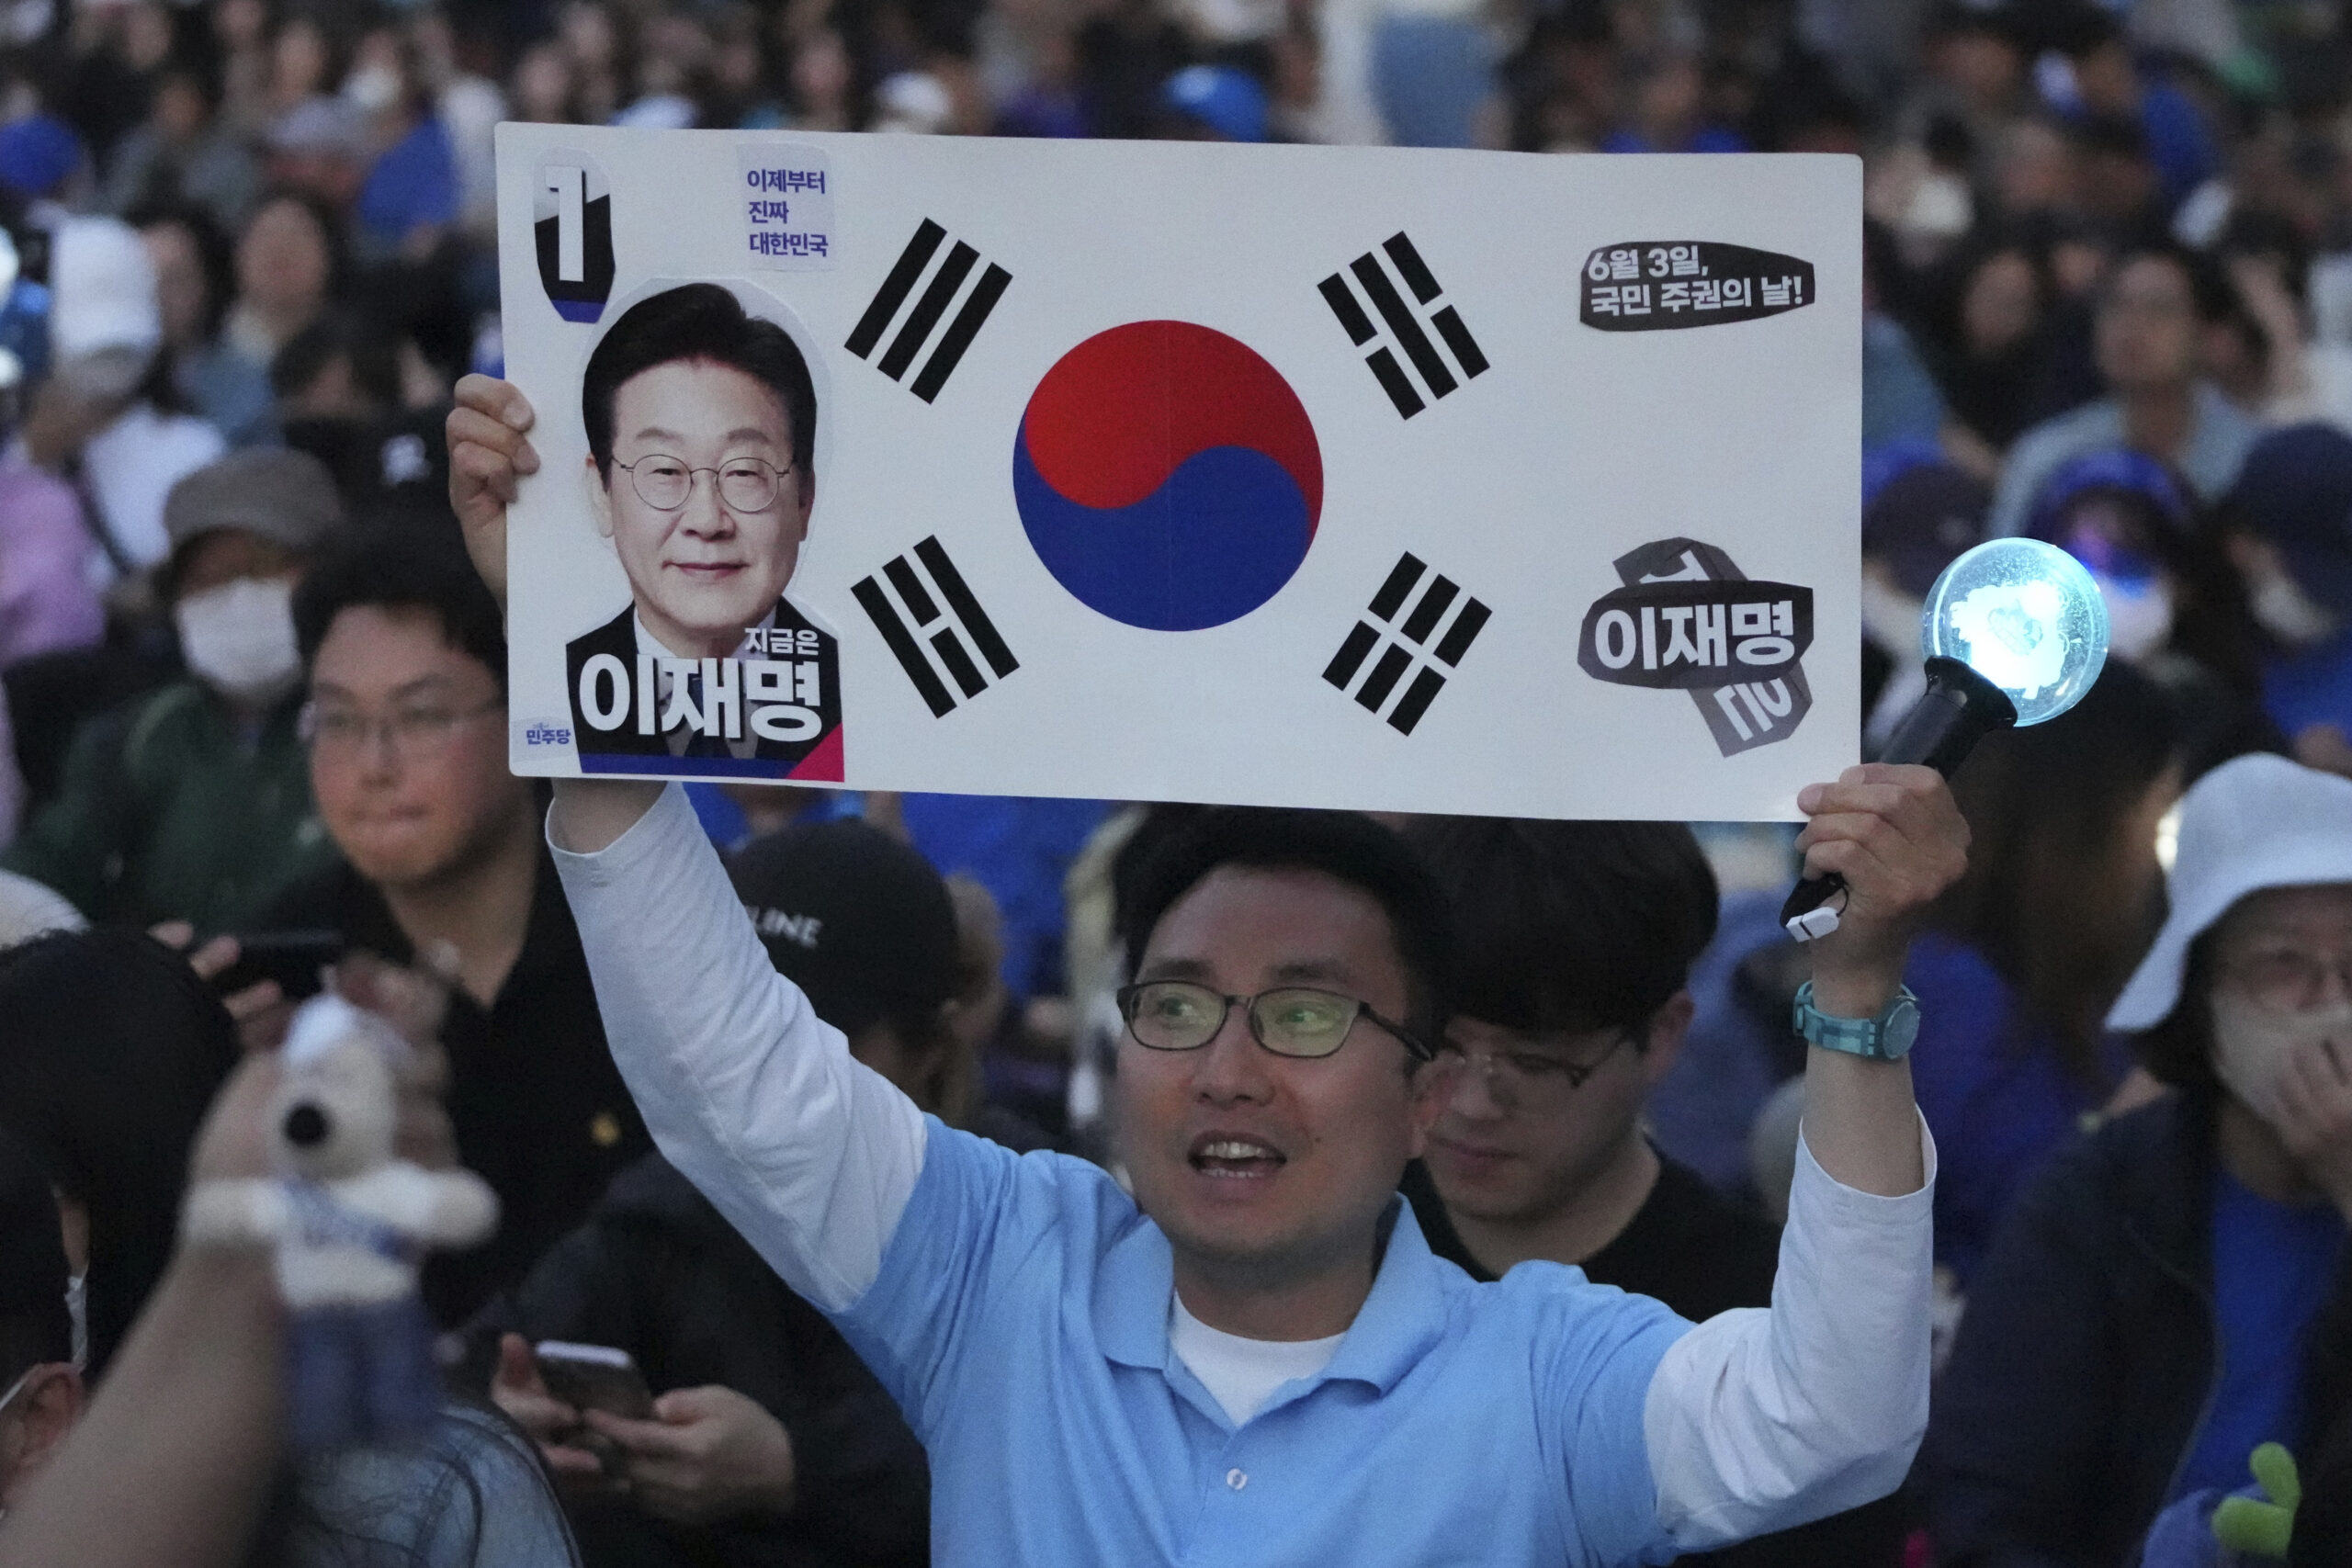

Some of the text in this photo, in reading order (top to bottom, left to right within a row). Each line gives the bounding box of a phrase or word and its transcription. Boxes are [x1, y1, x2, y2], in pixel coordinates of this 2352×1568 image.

[747, 169, 826, 194] 이제부터
[544, 165, 586, 283] 1
[749, 200, 789, 224] 진짜
[750, 231, 829, 257] 대한민국
[1588, 244, 1709, 281] 6월 3일,
[1590, 276, 1803, 317] 국민 주권의 날!
[744, 626, 820, 656] 지금은
[1595, 600, 1795, 671] 이재명
[579, 652, 822, 742] 이재명
[526, 728, 571, 745] 민주당
